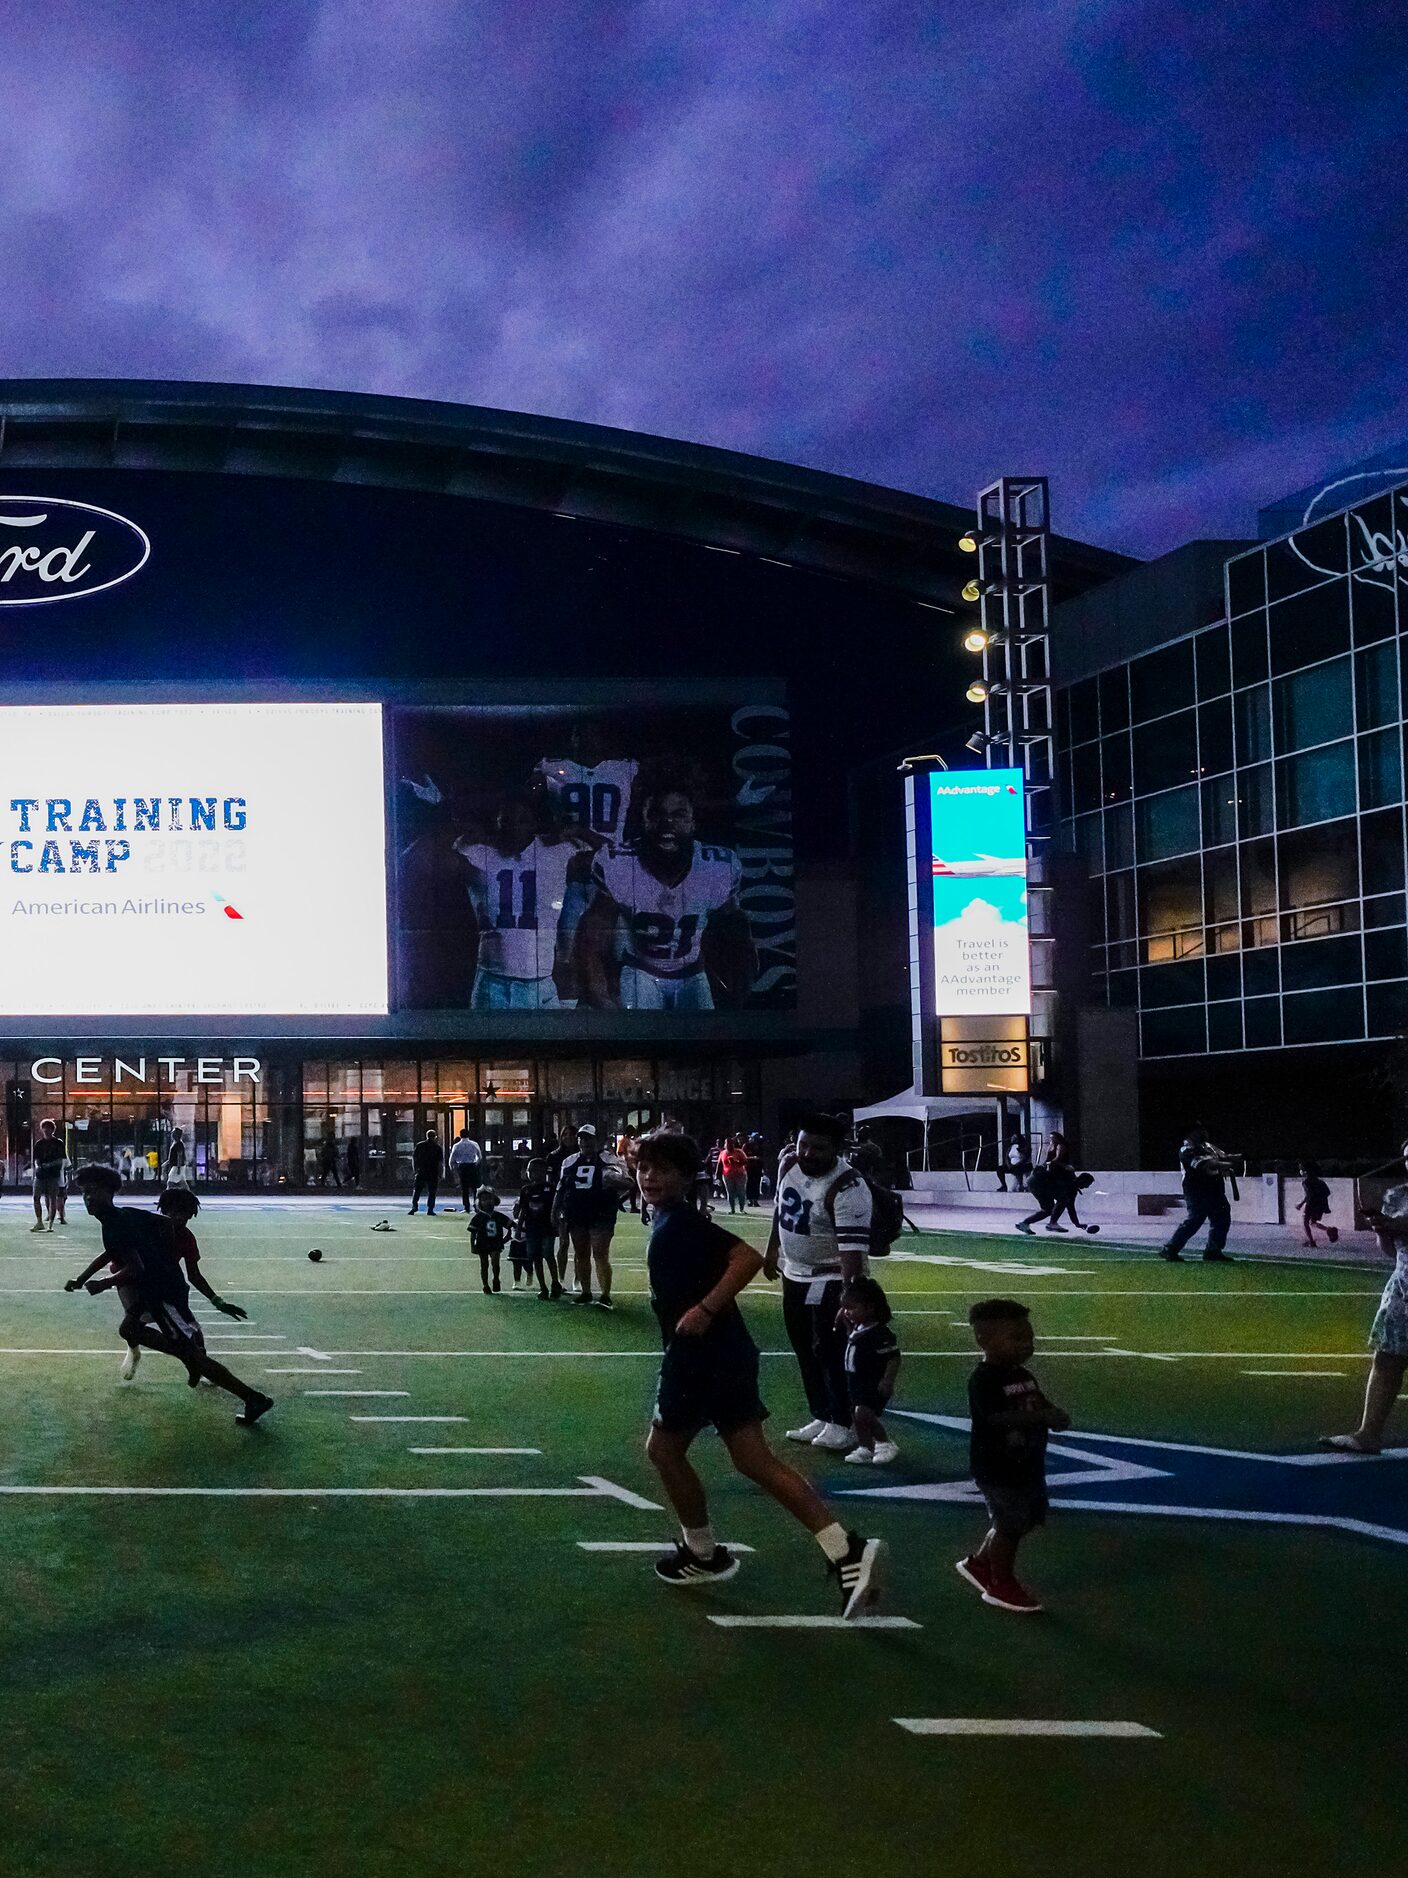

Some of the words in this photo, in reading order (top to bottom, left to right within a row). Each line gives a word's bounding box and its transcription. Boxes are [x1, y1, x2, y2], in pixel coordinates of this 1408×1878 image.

[10, 797, 247, 832] TRAINING
[10, 839, 130, 873] CAMP
[144, 839, 248, 873] 2022
[11, 898, 118, 916] American
[124, 898, 206, 915] Airlines
[495, 869, 539, 929] 11
[956, 938, 995, 949] Travel
[999, 939, 1009, 948] is
[962, 951, 1003, 961] better
[966, 964, 980, 972] as
[984, 964, 1000, 972] an
[940, 975, 1022, 985] AAdvantage
[956, 986, 1012, 996] member
[30, 1057, 262, 1083] CENTER
[574, 1165, 596, 1189] 9
[780, 1186, 814, 1236] 21
